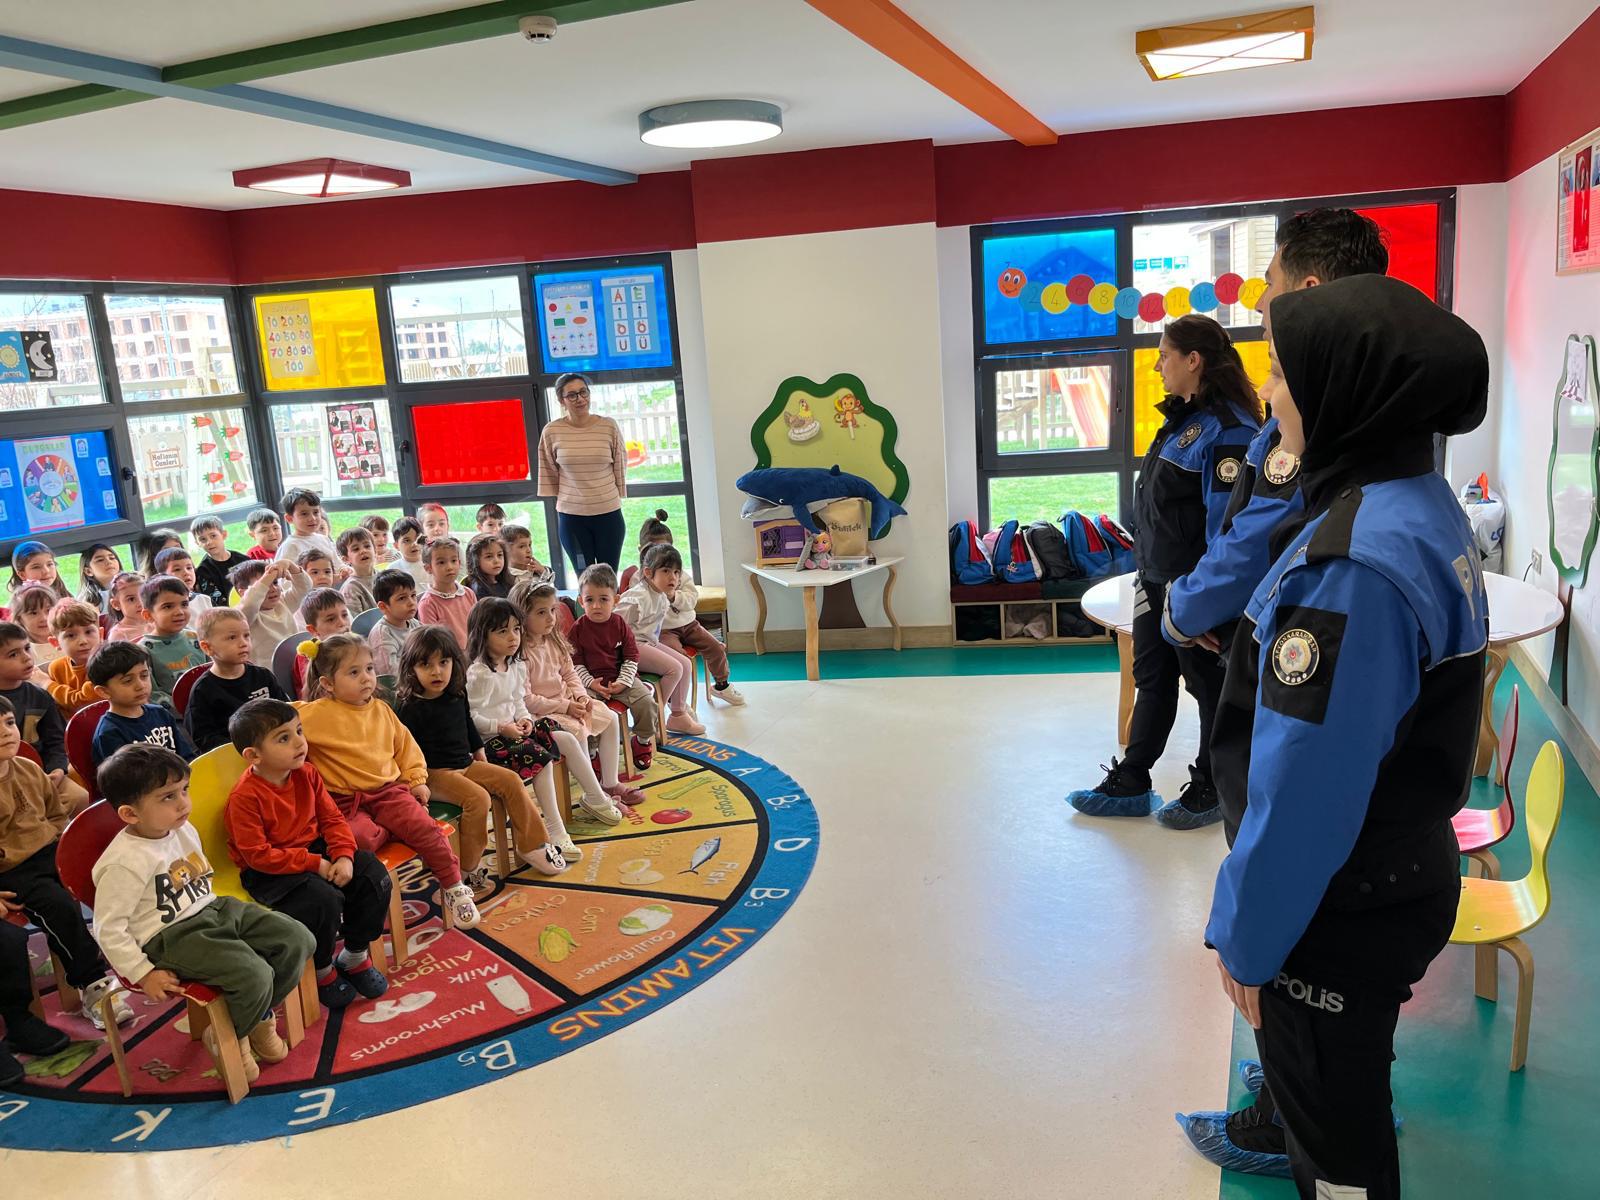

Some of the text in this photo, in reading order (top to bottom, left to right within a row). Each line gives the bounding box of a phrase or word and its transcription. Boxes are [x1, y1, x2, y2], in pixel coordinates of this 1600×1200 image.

[615, 286, 643, 302] A E
[1029, 286, 1041, 304] 2
[1051, 289, 1059, 306] 4
[1100, 289, 1109, 305] 8
[1121, 294, 1136, 307] 10
[285, 360, 303, 371] 100
[665, 737, 737, 761] AMINS
[731, 767, 762, 777] A
[774, 837, 812, 852] D
[704, 861, 739, 886] Fish
[574, 929, 676, 980] Cauliflower
[391, 950, 473, 989] Alligat
[448, 963, 499, 984] Milk
[548, 927, 756, 1041] VITAMINS
[350, 1000, 486, 1061] Mushrooms
[287, 1088, 335, 1126] E
[111, 1107, 173, 1143] K
